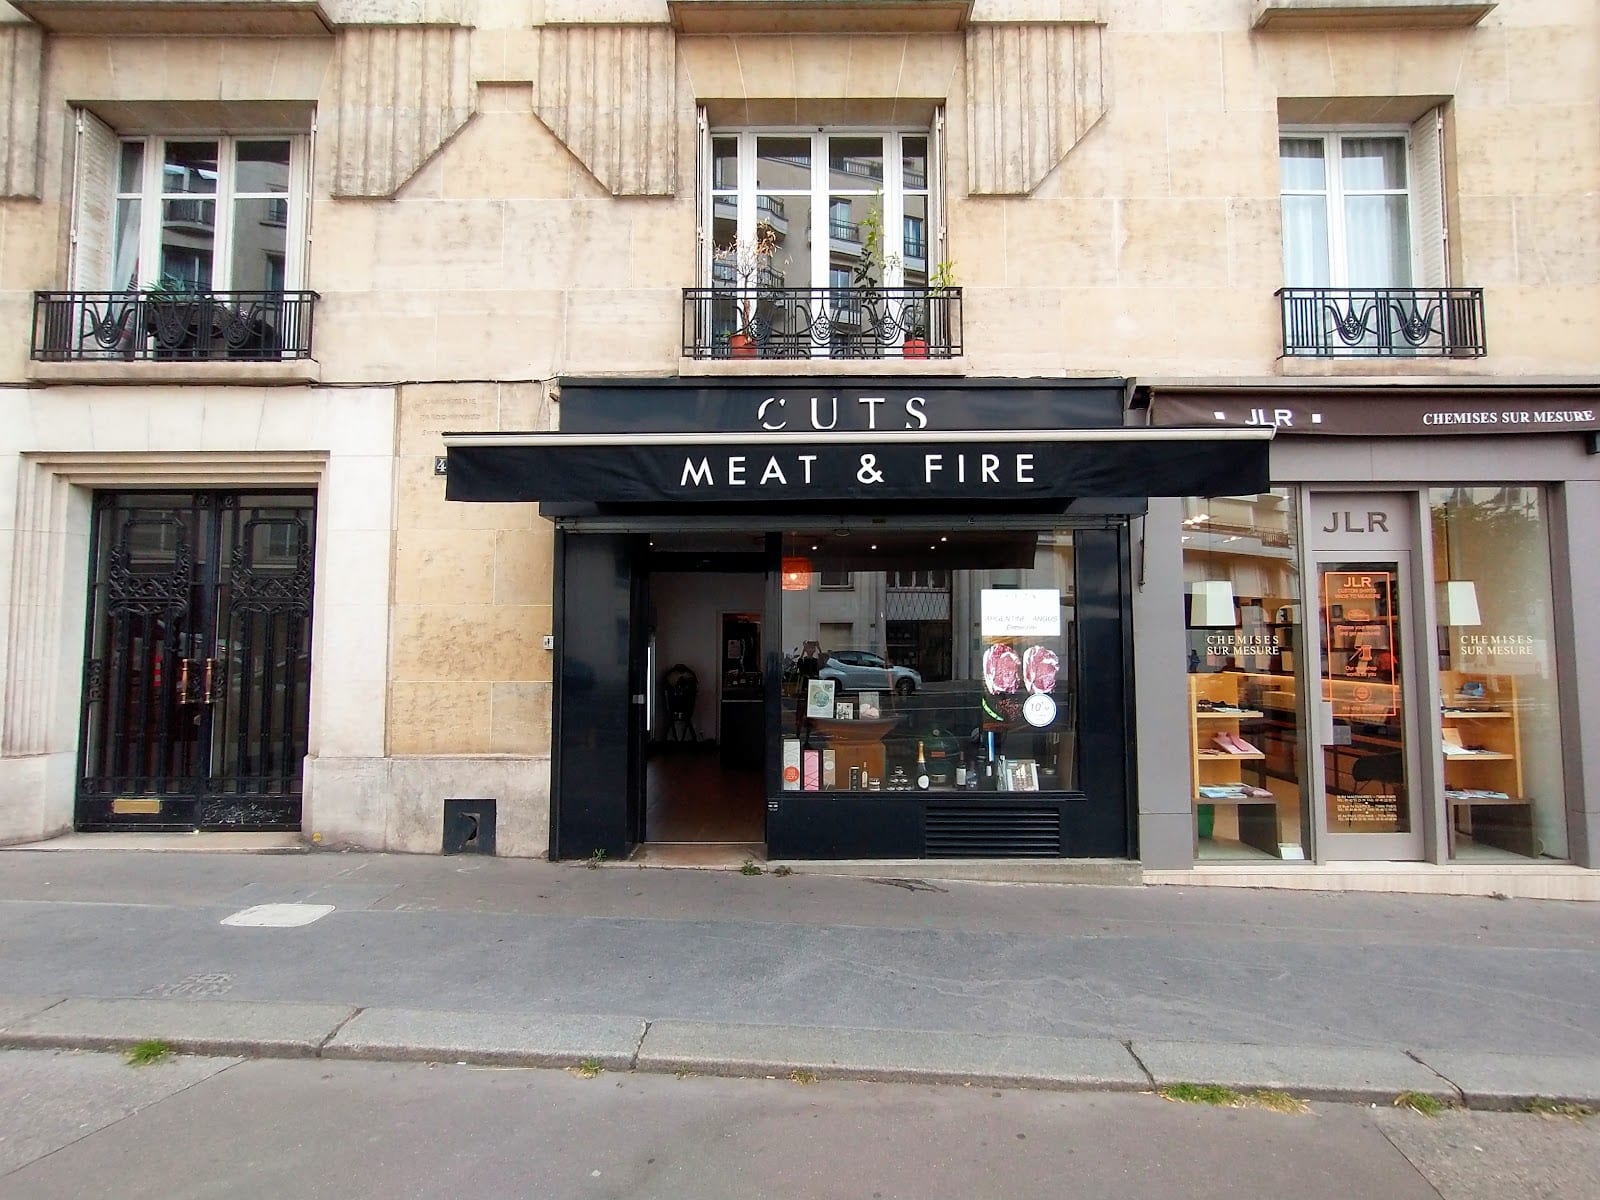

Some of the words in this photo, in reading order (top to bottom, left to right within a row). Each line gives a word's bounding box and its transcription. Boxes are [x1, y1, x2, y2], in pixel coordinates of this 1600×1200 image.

[758, 397, 928, 429] CUTS
[1245, 408, 1293, 427] JLR
[1422, 412, 1498, 425] CHEMISES
[1501, 411, 1530, 424] SUR
[1533, 410, 1596, 423] MESURE
[680, 455, 817, 486] MEAT
[856, 453, 885, 484] &
[925, 453, 1034, 483] FIRE
[1323, 511, 1389, 533] JLR
[1343, 576, 1371, 588] JLR
[1206, 635, 1279, 645] CHEMISES
[1460, 635, 1533, 645] CHEMISES
[1207, 646, 1229, 656] SUR
[1233, 646, 1280, 656] MESURE
[1460, 646, 1483, 656] SUR
[1487, 646, 1533, 656] MESURE
